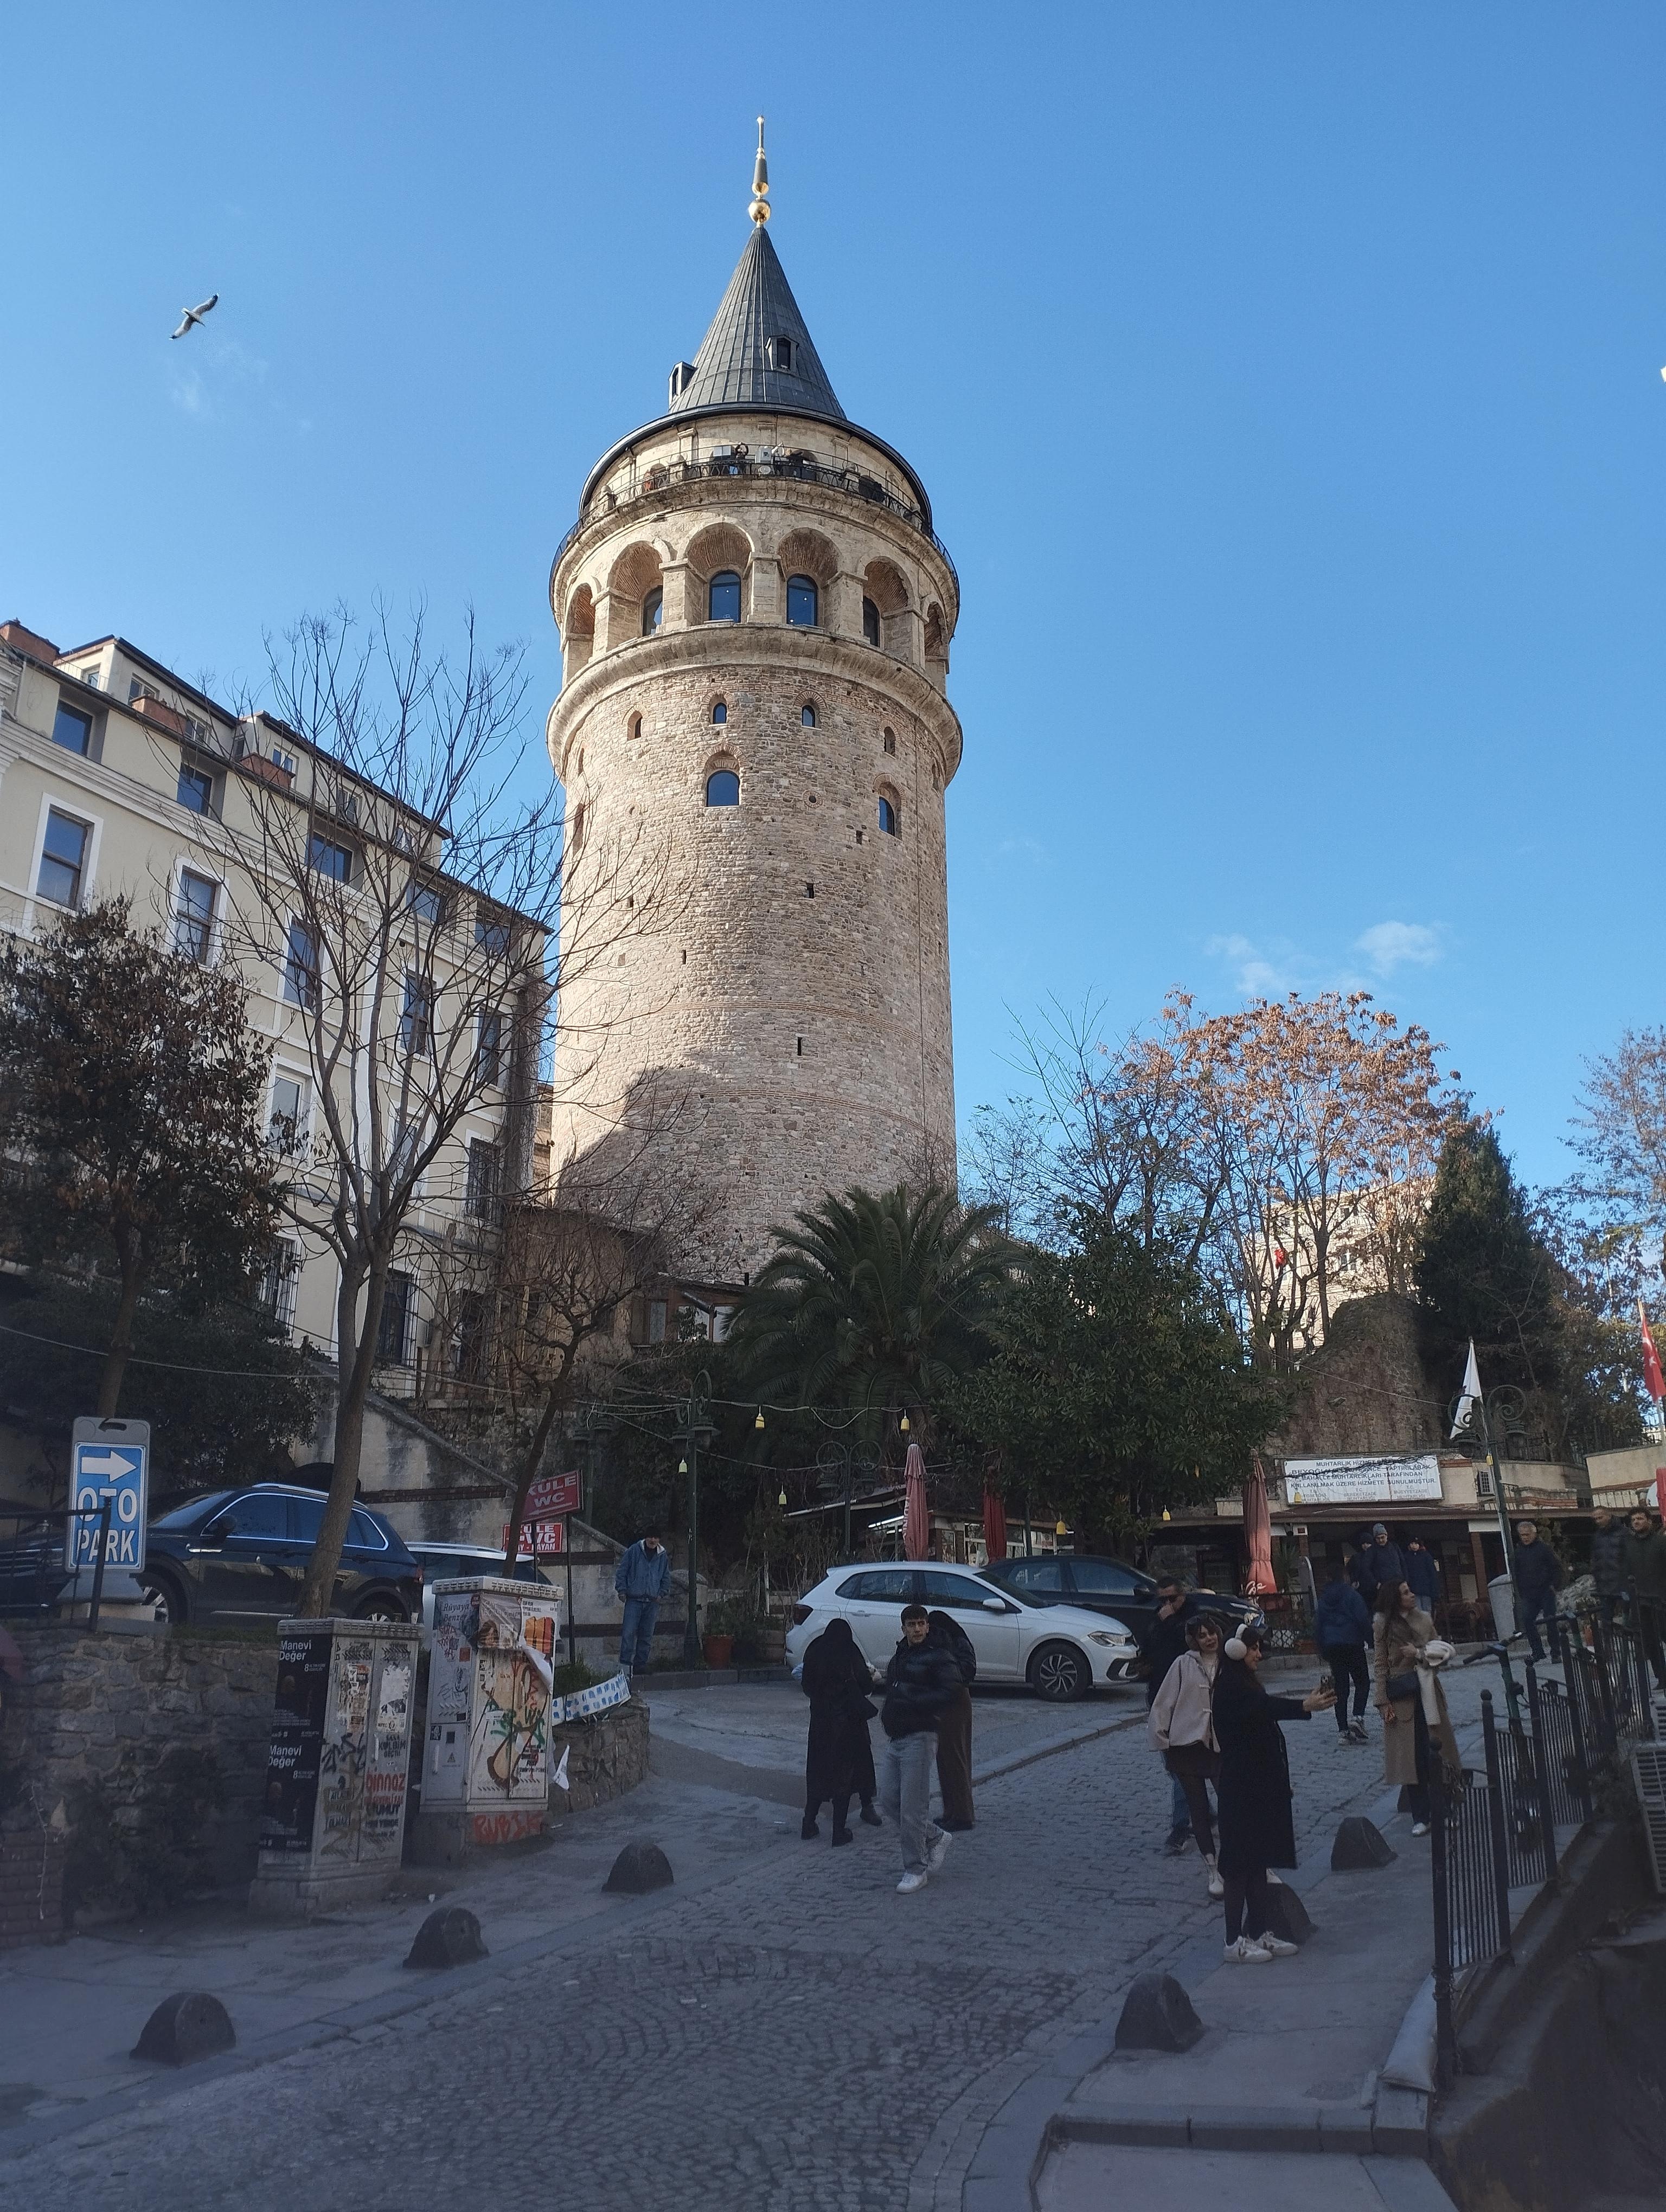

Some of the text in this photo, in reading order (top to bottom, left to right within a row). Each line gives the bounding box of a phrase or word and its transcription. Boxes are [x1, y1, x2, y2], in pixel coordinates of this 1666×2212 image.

[534, 1492, 565, 1507] WC
[520, 1525, 554, 1533] ULE
[77, 1529, 135, 1562] PARK
[443, 1603, 469, 1612] Rüyaya
[444, 1613, 467, 1622] Benzer
[280, 1639, 312, 1651] Manevi
[279, 1650, 306, 1663] Değer
[304, 1663, 309, 1672] 8
[269, 1745, 302, 1756] Manevi
[293, 1770, 298, 1779] 8
